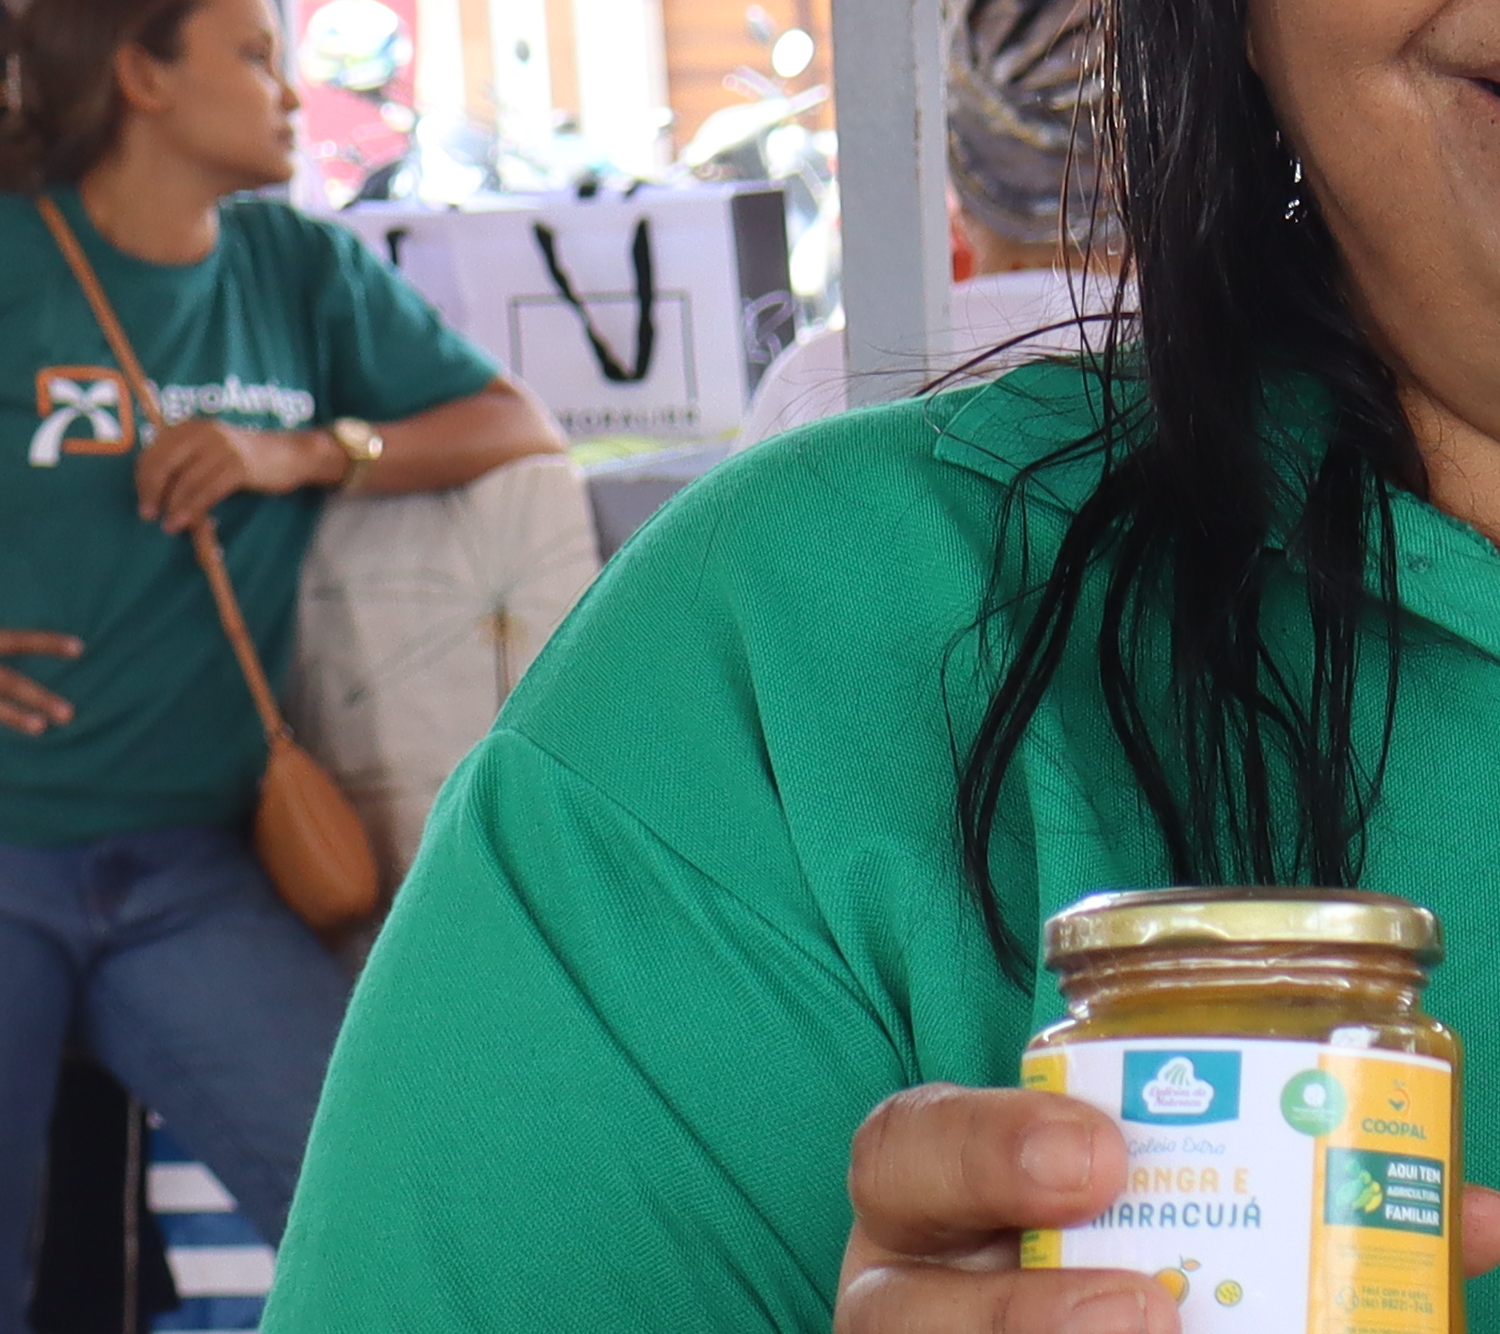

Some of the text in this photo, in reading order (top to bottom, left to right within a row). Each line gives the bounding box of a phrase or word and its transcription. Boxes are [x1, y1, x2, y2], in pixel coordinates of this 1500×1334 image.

[1361, 1118, 1428, 1140] COOPAL
[1132, 1166, 1250, 1194] ANGA E
[1387, 1162, 1418, 1180] AQUI
[1384, 1203, 1441, 1227] FAMILIAR
